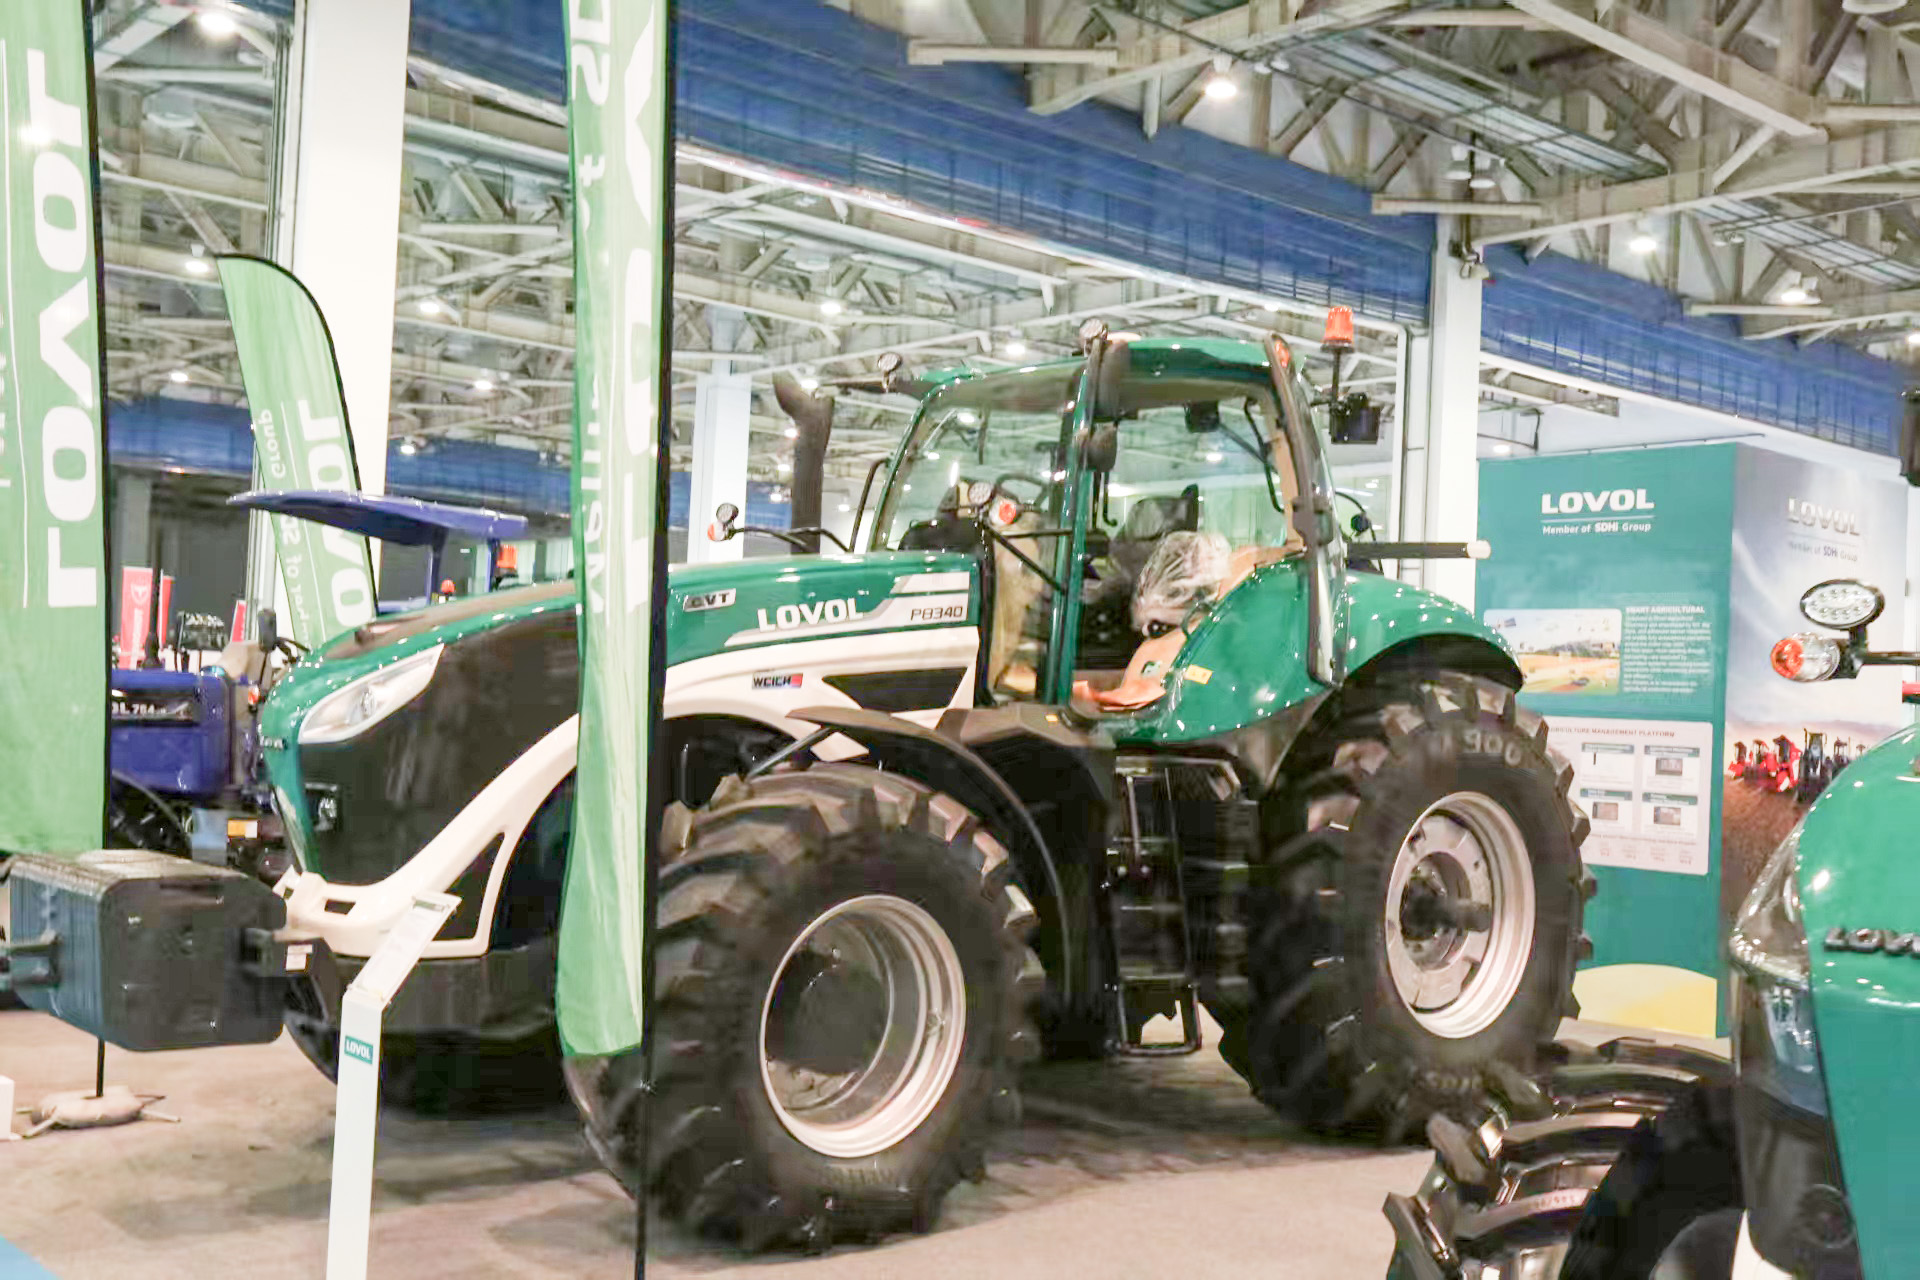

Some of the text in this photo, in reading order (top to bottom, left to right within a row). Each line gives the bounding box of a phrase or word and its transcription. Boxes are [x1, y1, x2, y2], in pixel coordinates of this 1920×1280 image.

[1541, 488, 1655, 514] LOVOL
[1542, 525, 1579, 535] Member
[1581, 523, 1591, 533] of
[1622, 522, 1652, 533] Group
[1788, 498, 1860, 536] LOVOL
[757, 597, 864, 633] LOVOL
[910, 606, 963, 621] P8340
[345, 1039, 370, 1060] LOVOL
